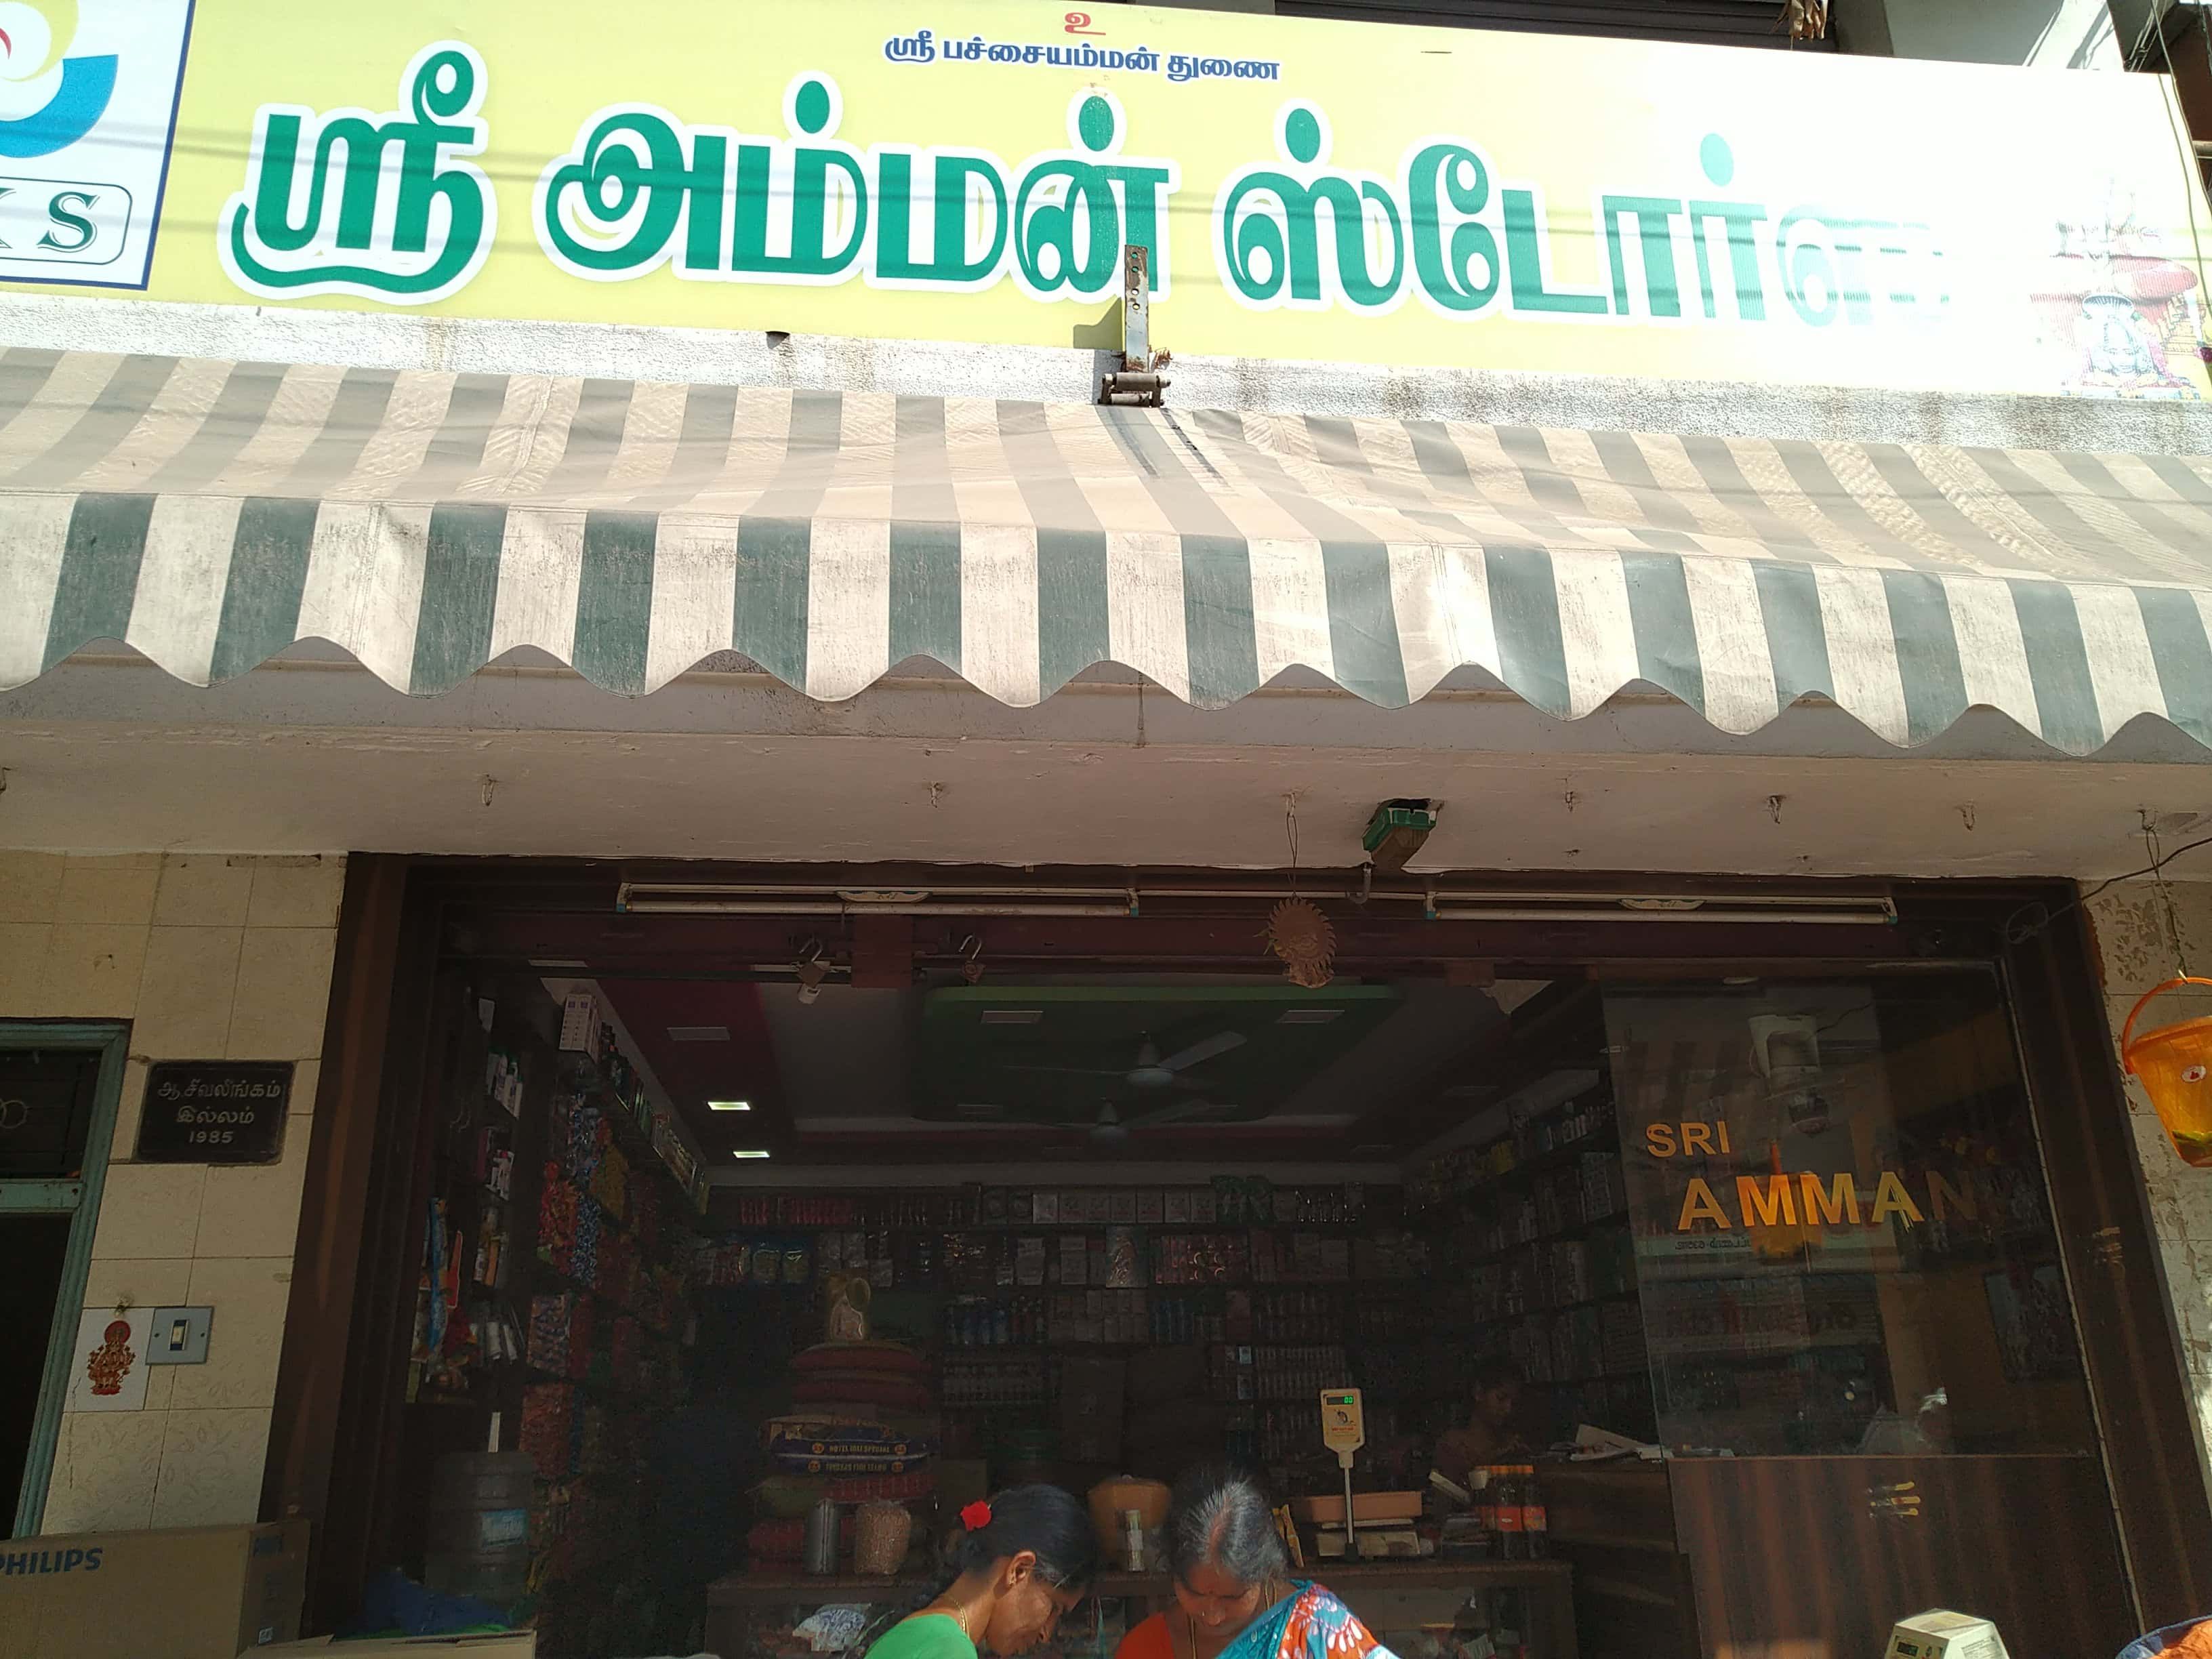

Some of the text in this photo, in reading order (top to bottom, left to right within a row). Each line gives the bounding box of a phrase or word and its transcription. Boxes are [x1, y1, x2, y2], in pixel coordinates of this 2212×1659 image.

[943, 36, 1160, 72] பச்சையம்மன்
[1166, 55, 1280, 82] துணை
[544, 80, 1170, 293] அம்மன்
[176, 1105, 255, 1125] இல்லம்
[189, 1130, 234, 1144] 1985
[1645, 1120, 1731, 1158] SRI
[1677, 1170, 1978, 1231] AMMAN
